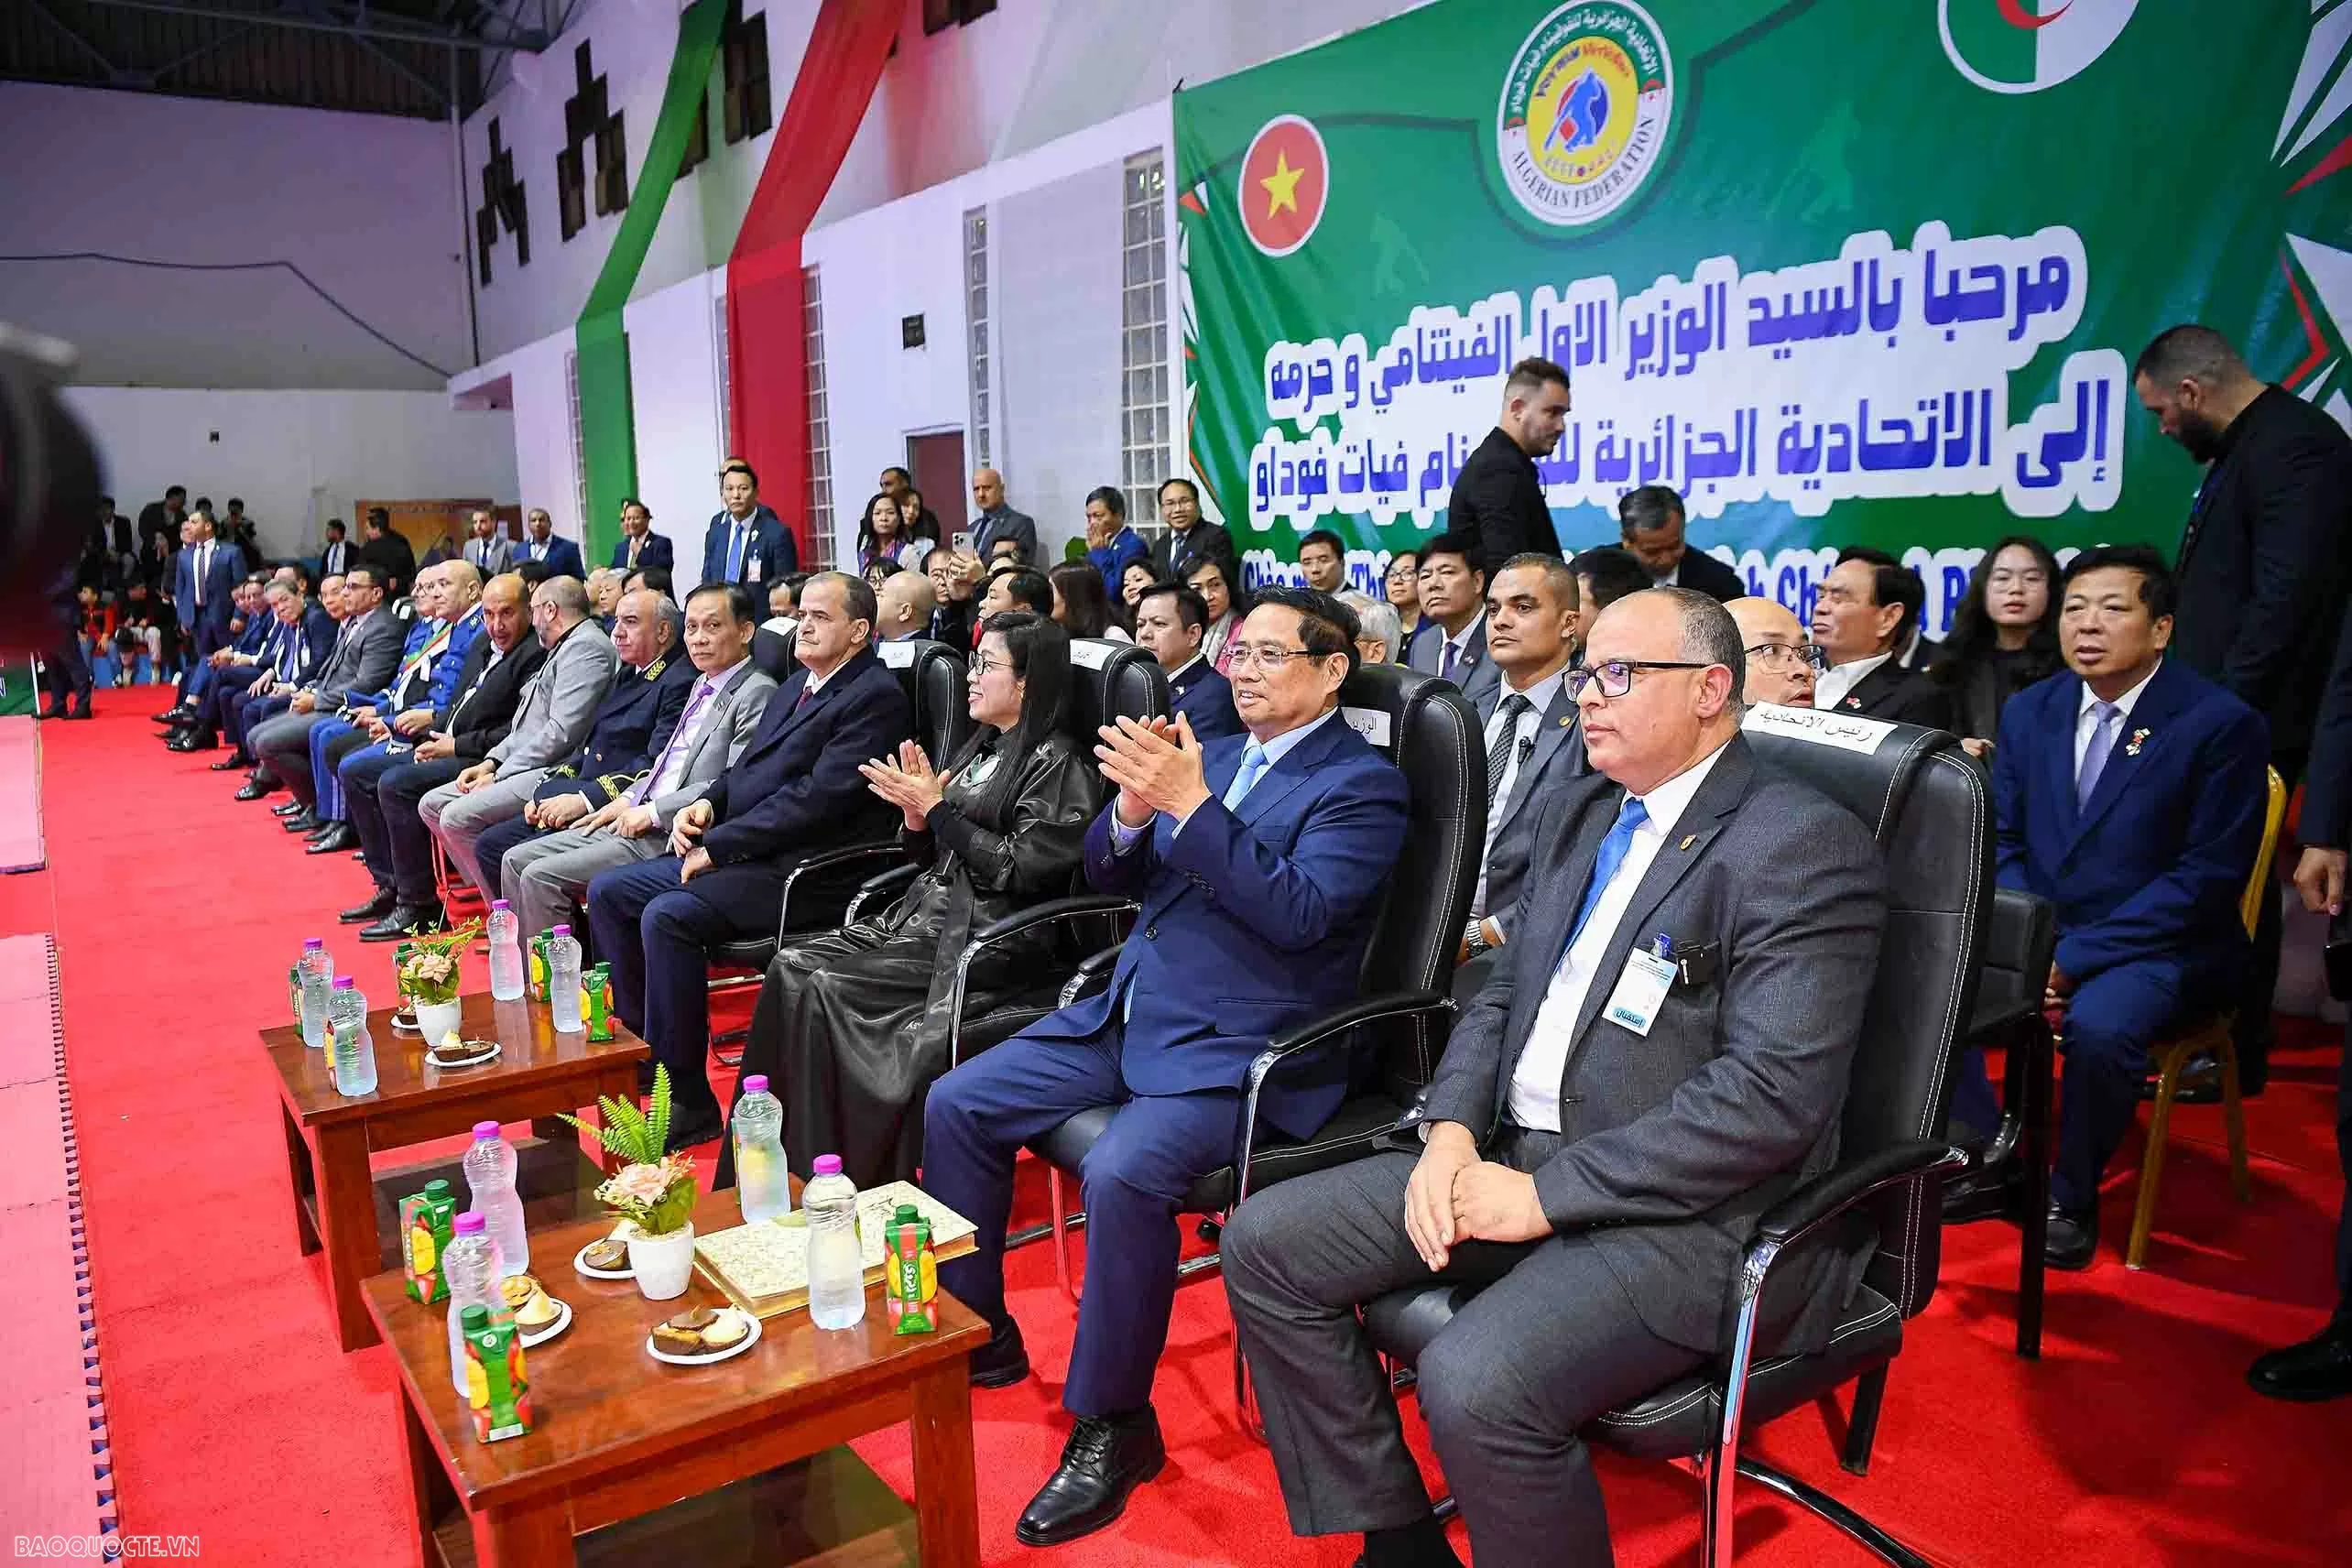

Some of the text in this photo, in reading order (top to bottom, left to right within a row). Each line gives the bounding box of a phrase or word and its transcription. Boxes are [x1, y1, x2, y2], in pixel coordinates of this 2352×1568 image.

[1513, 117, 1655, 209] ALGERIAN FEDERATION
[1625, 280, 1726, 381] الوزير
[1748, 257, 1902, 360] بالسيد
[1924, 248, 2070, 342] مرحبا
[1270, 356, 1334, 412] حرمه
[1345, 352, 1360, 409] و
[1370, 313, 1513, 414] الفيتنامي
[1338, 439, 1408, 506] فيات
[1595, 406, 1758, 497] الجزائرية
[1777, 388, 1993, 490] الاتحادية
[2016, 378, 2111, 488] إلى
[1759, 710, 1873, 742] رئيس الاتحادية
